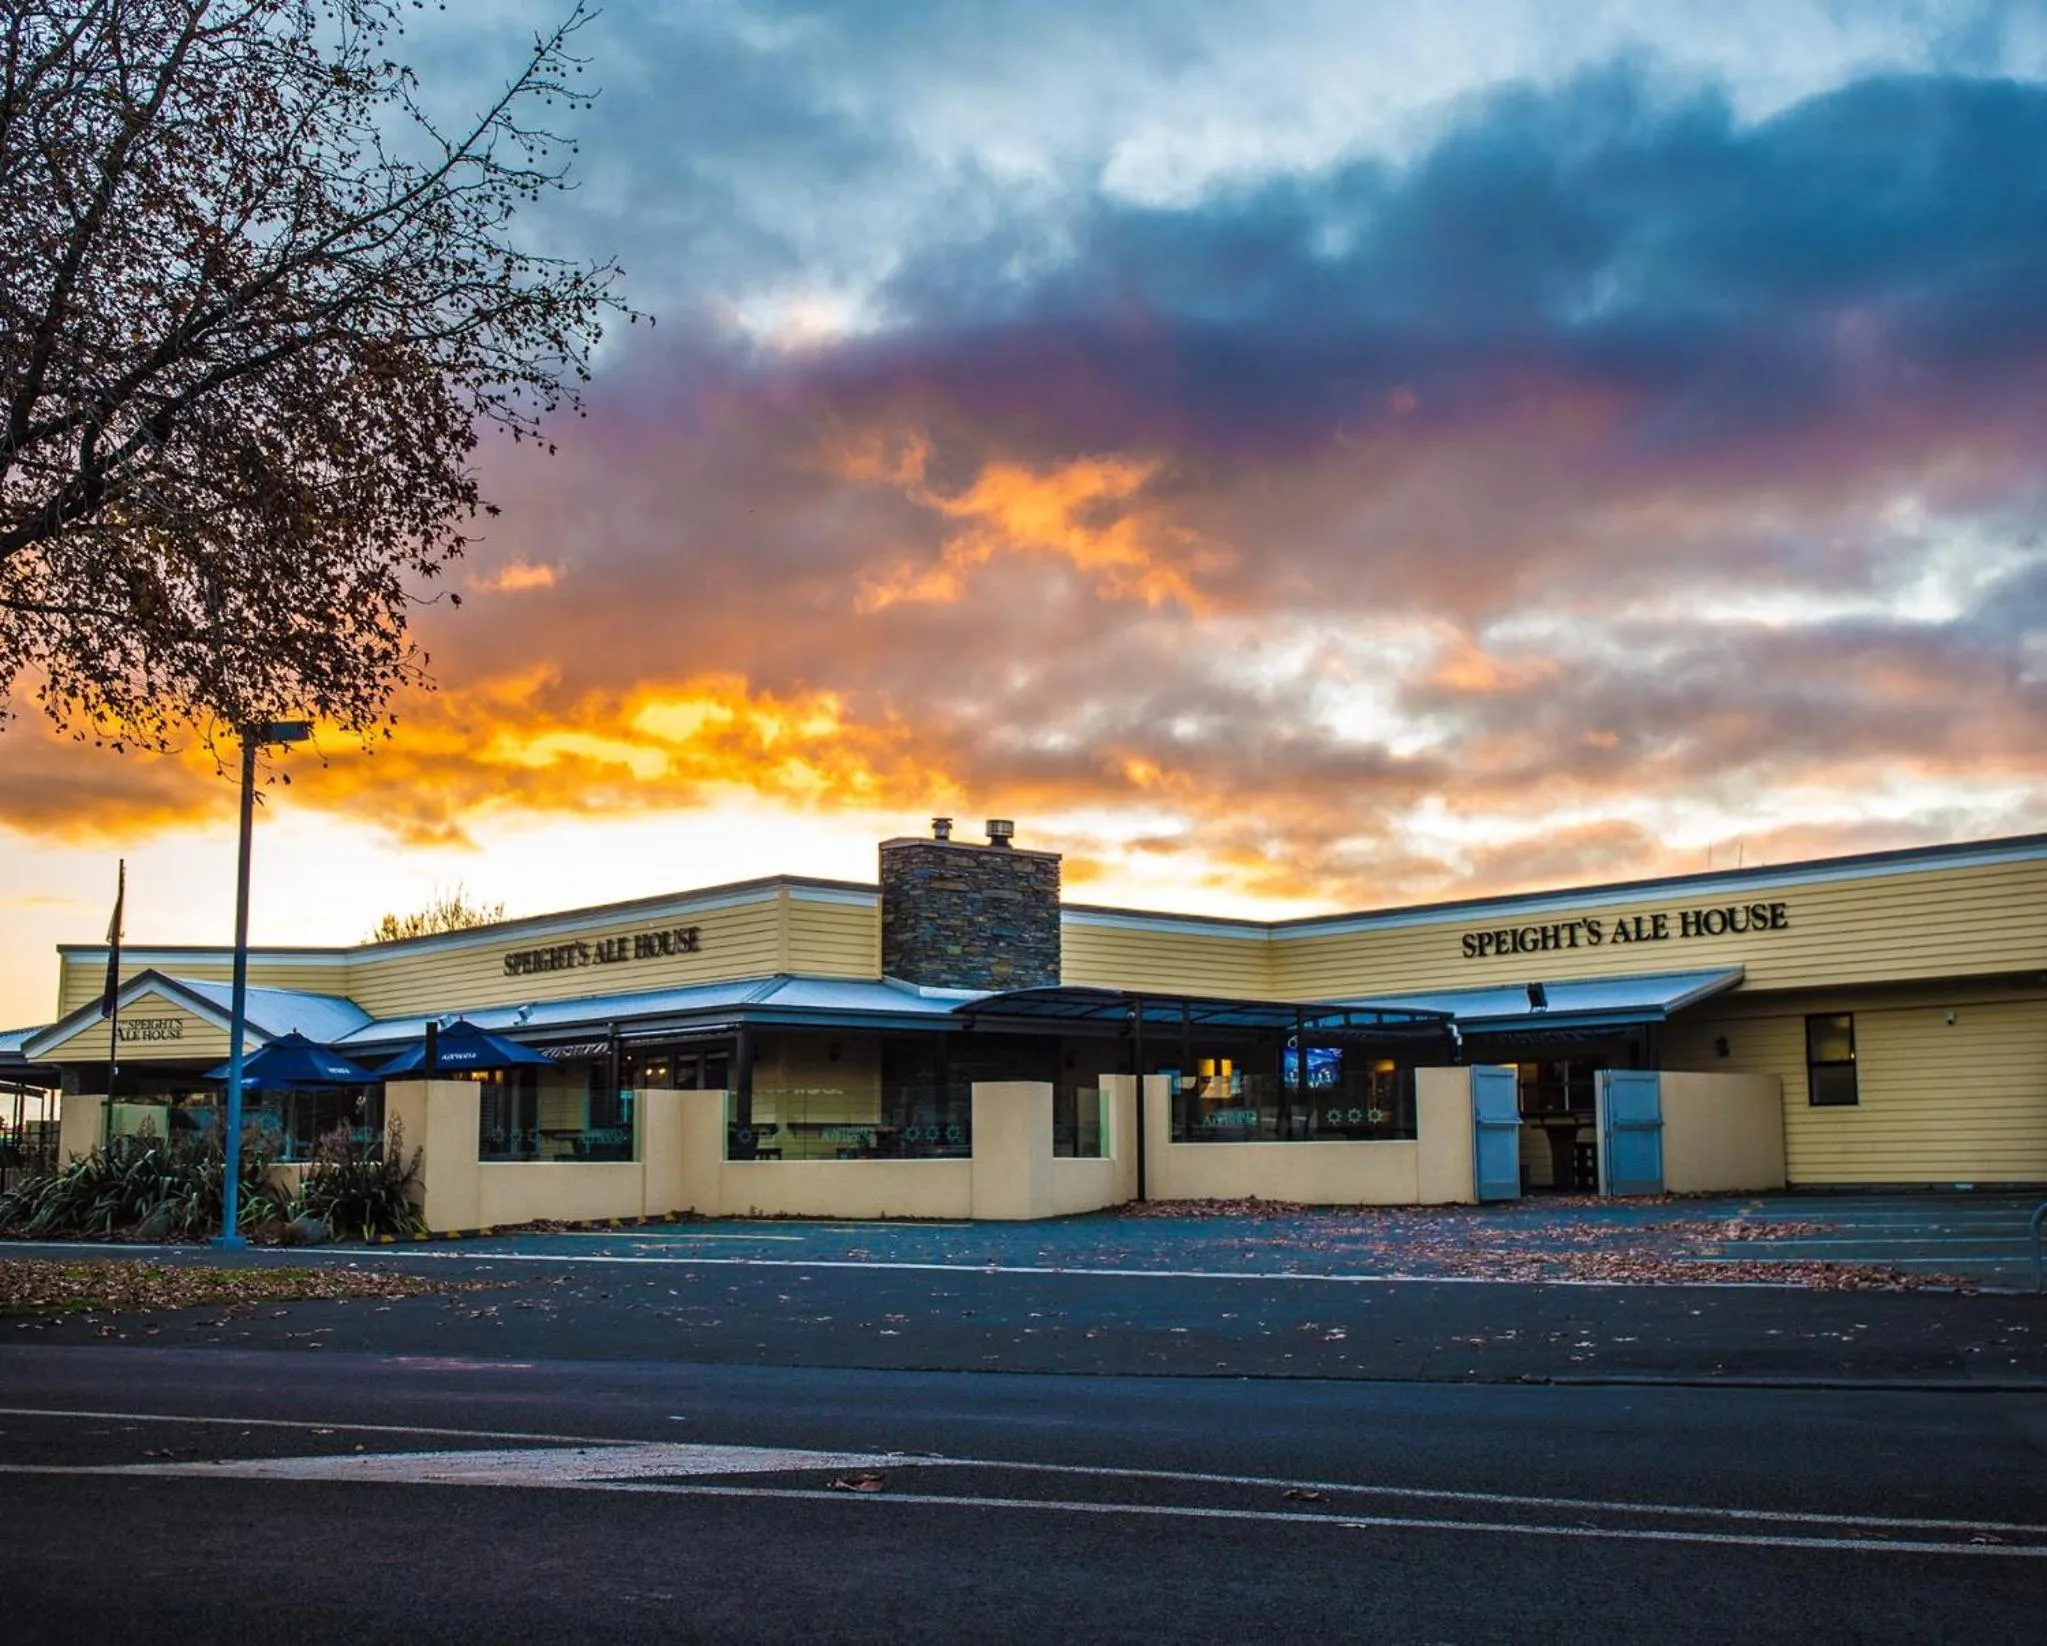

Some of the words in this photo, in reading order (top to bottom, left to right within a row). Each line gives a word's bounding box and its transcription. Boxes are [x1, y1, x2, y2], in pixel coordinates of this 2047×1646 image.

[504, 940, 591, 976] SPEIGHT'S
[593, 936, 630, 965] ALE
[634, 926, 702, 960] HOUSE
[1462, 917, 1601, 958] SPEIGHT'S
[1610, 913, 1669, 944] ALE
[1679, 902, 1788, 938] HOUSE
[142, 1028, 183, 1041] HOUSE
